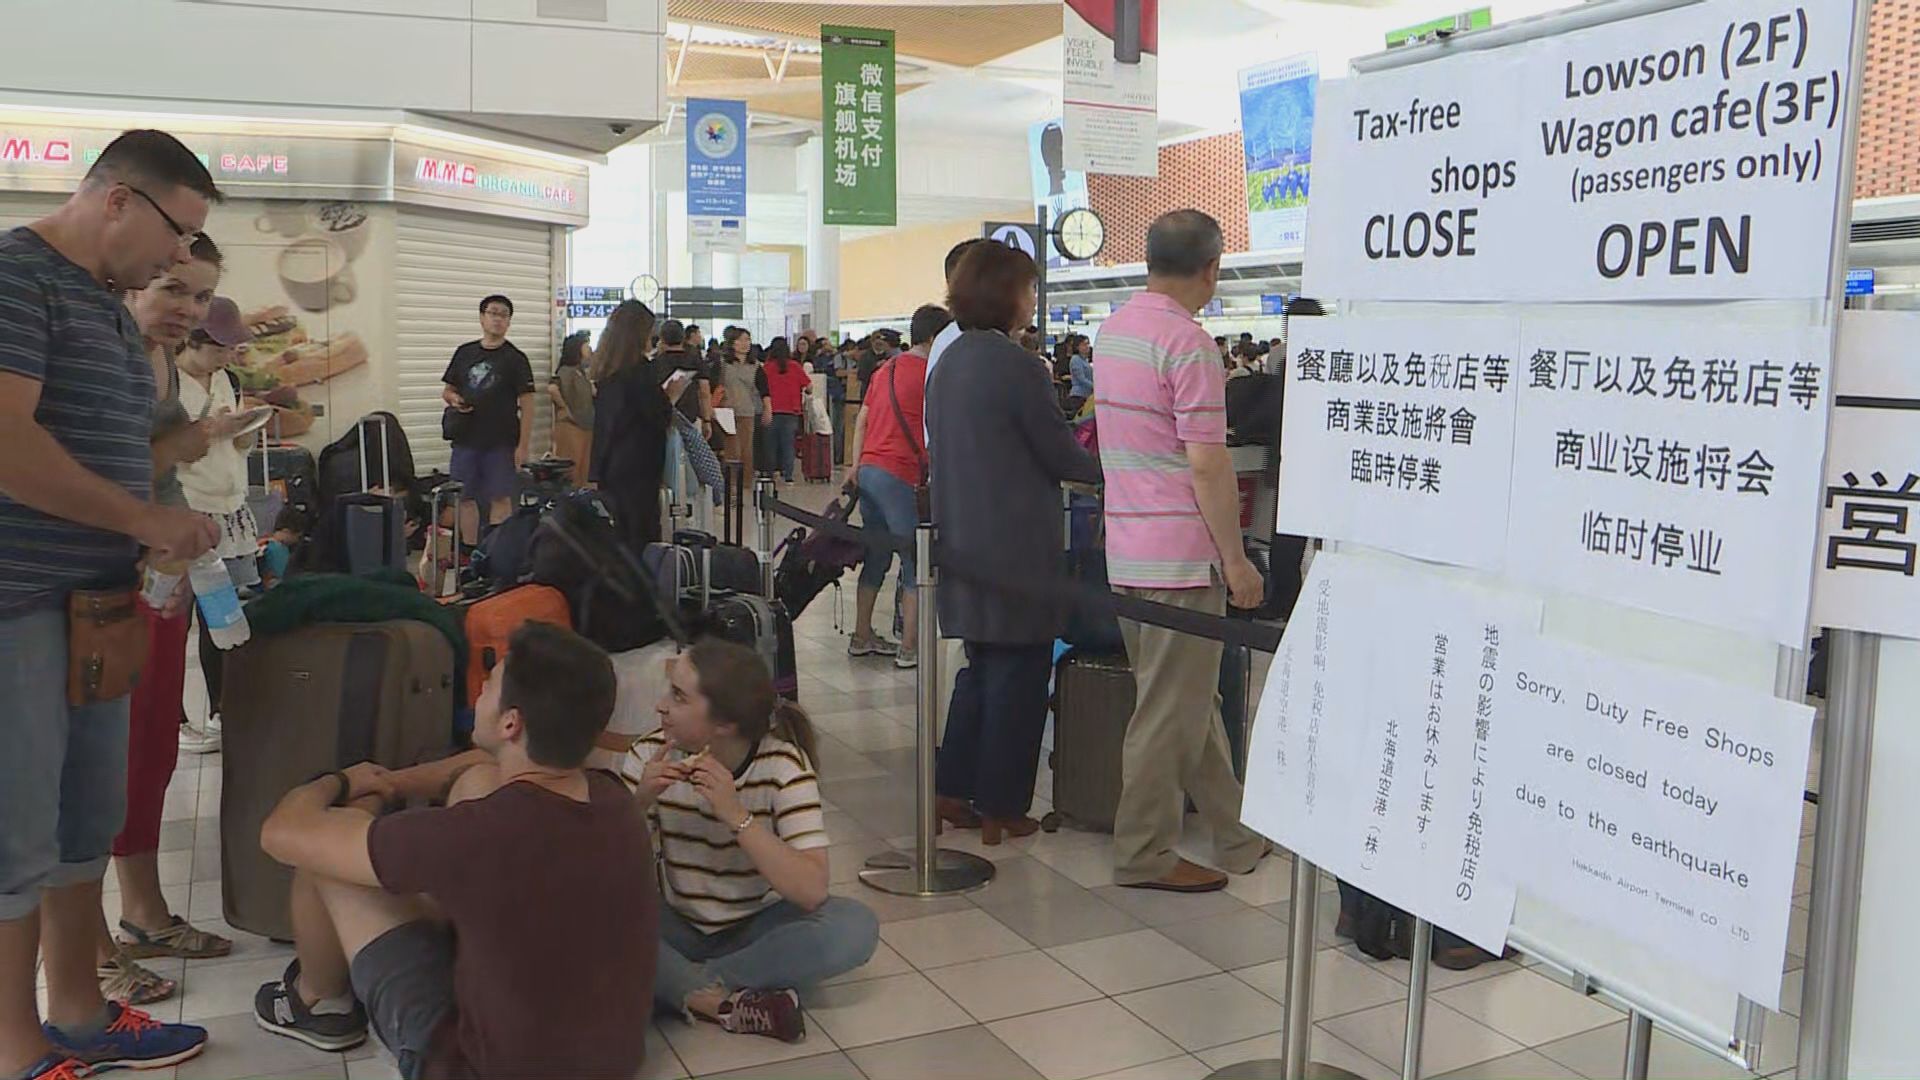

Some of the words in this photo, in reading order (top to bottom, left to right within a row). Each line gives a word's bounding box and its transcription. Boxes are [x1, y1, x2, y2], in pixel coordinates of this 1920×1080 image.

[1565, 43, 1706, 100] Lowson
[1720, 7, 1809, 81] (2F)
[834, 81, 857, 187] 旗舰机场
[860, 62, 883, 167] 微信支付
[1353, 97, 1461, 142] Tax-free
[1541, 113, 1658, 160] Wagon
[220, 153, 288, 173] CAFE
[1430, 155, 1517, 199] shops
[1571, 157, 1726, 204] (passengers
[1736, 135, 1822, 183] only)
[1364, 207, 1479, 260] CLOSE
[1596, 214, 1752, 280] OPEN
[568, 304, 605, 317] 19-24
[1528, 347, 1821, 411] 餐厅以及免税店等
[1326, 397, 1477, 446] 商業設施將會
[1350, 447, 1442, 494] 臨時停業
[1555, 428, 1775, 497] 商业设施将会
[1581, 509, 1723, 576] 临时停业
[1415, 633, 1449, 853] 営業はお休みします。
[1455, 623, 1500, 902] 地震の影響により免税店の
[1586, 692, 1629, 724] Duty
[1642, 708, 1689, 740] Free
[1704, 727, 1774, 768] Shops
[1546, 743, 1575, 763] are
[1586, 753, 1648, 789] closed
[1661, 778, 1719, 817] today
[1515, 783, 1547, 810] due
[1558, 799, 1575, 820] to
[1588, 810, 1618, 837] the
[1631, 834, 1748, 888] earthquake
[1617, 876, 1649, 898] Airport
[1654, 892, 1695, 918] Terminal
